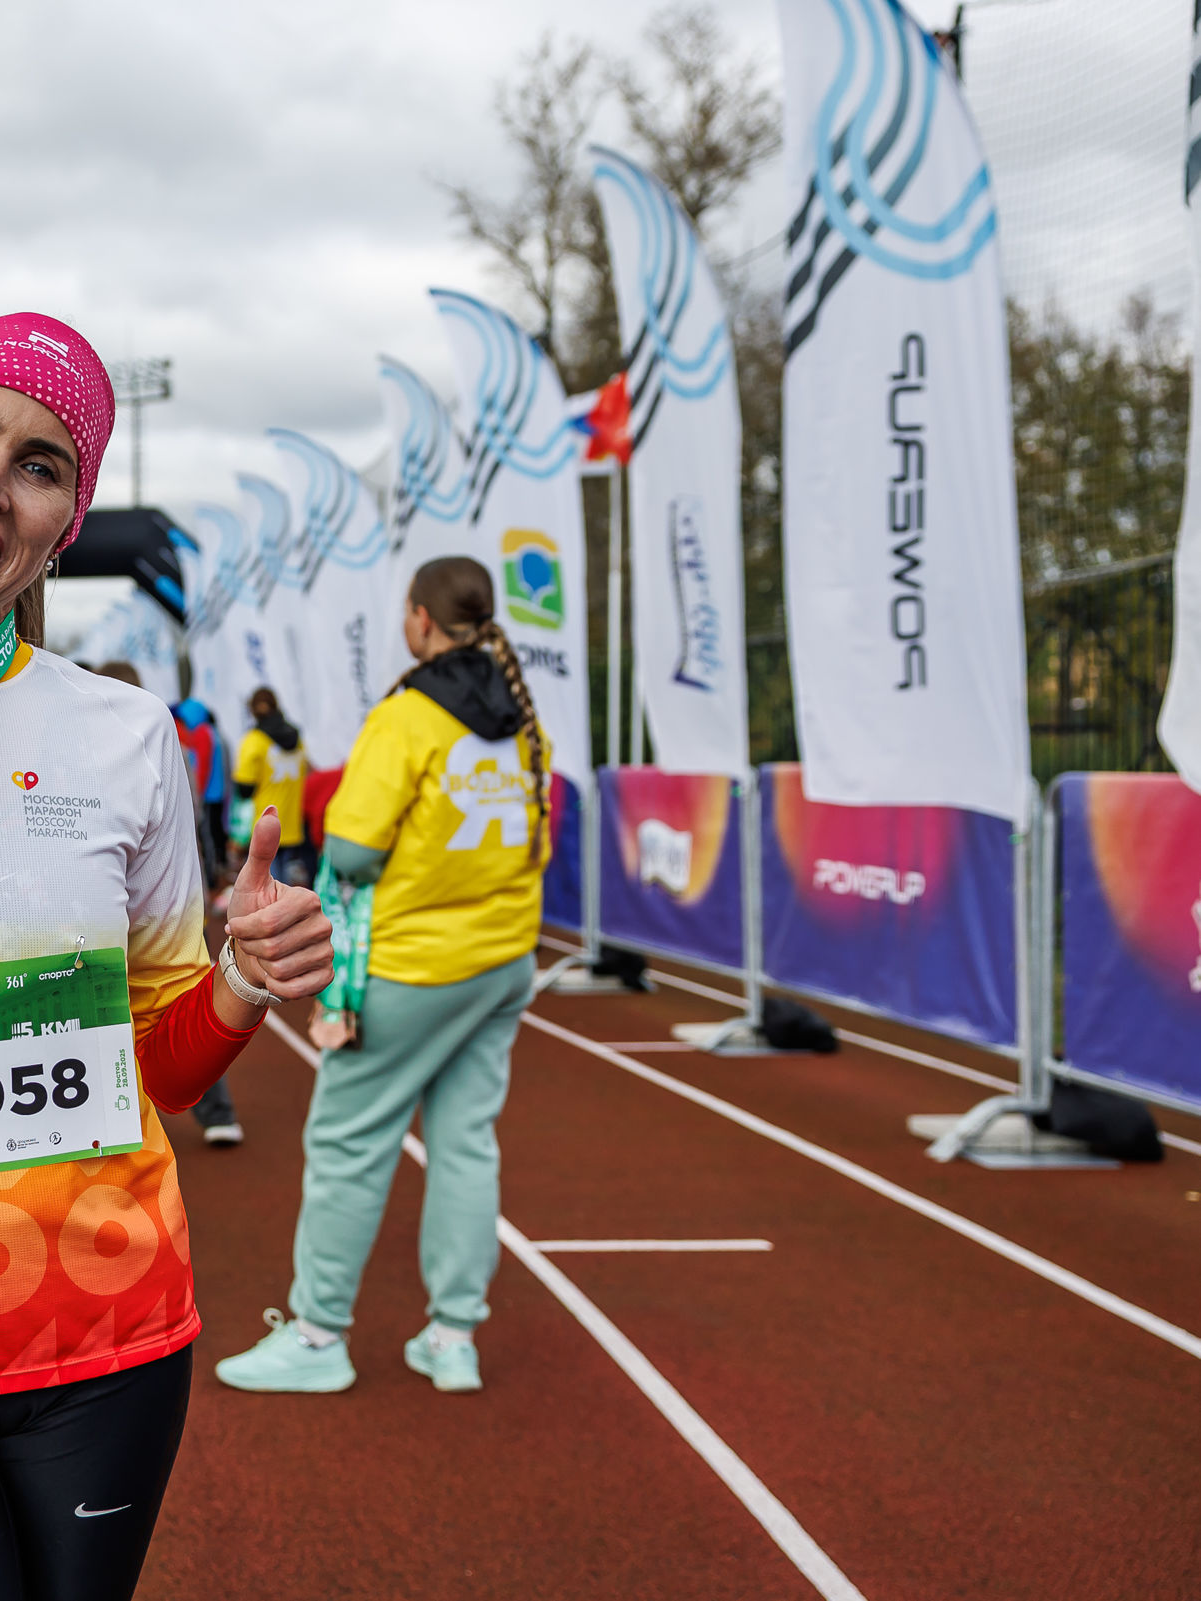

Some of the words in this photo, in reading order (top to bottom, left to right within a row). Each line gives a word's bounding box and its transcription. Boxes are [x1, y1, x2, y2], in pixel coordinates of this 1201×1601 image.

[23, 794, 101, 809] МОСКОВСКИЙ
[24, 805, 82, 818] МАРАФОН
[26, 816, 76, 828] MOSCOW
[27, 827, 88, 840] MARATHON
[118, 1048, 129, 1088] 28.09.2025
